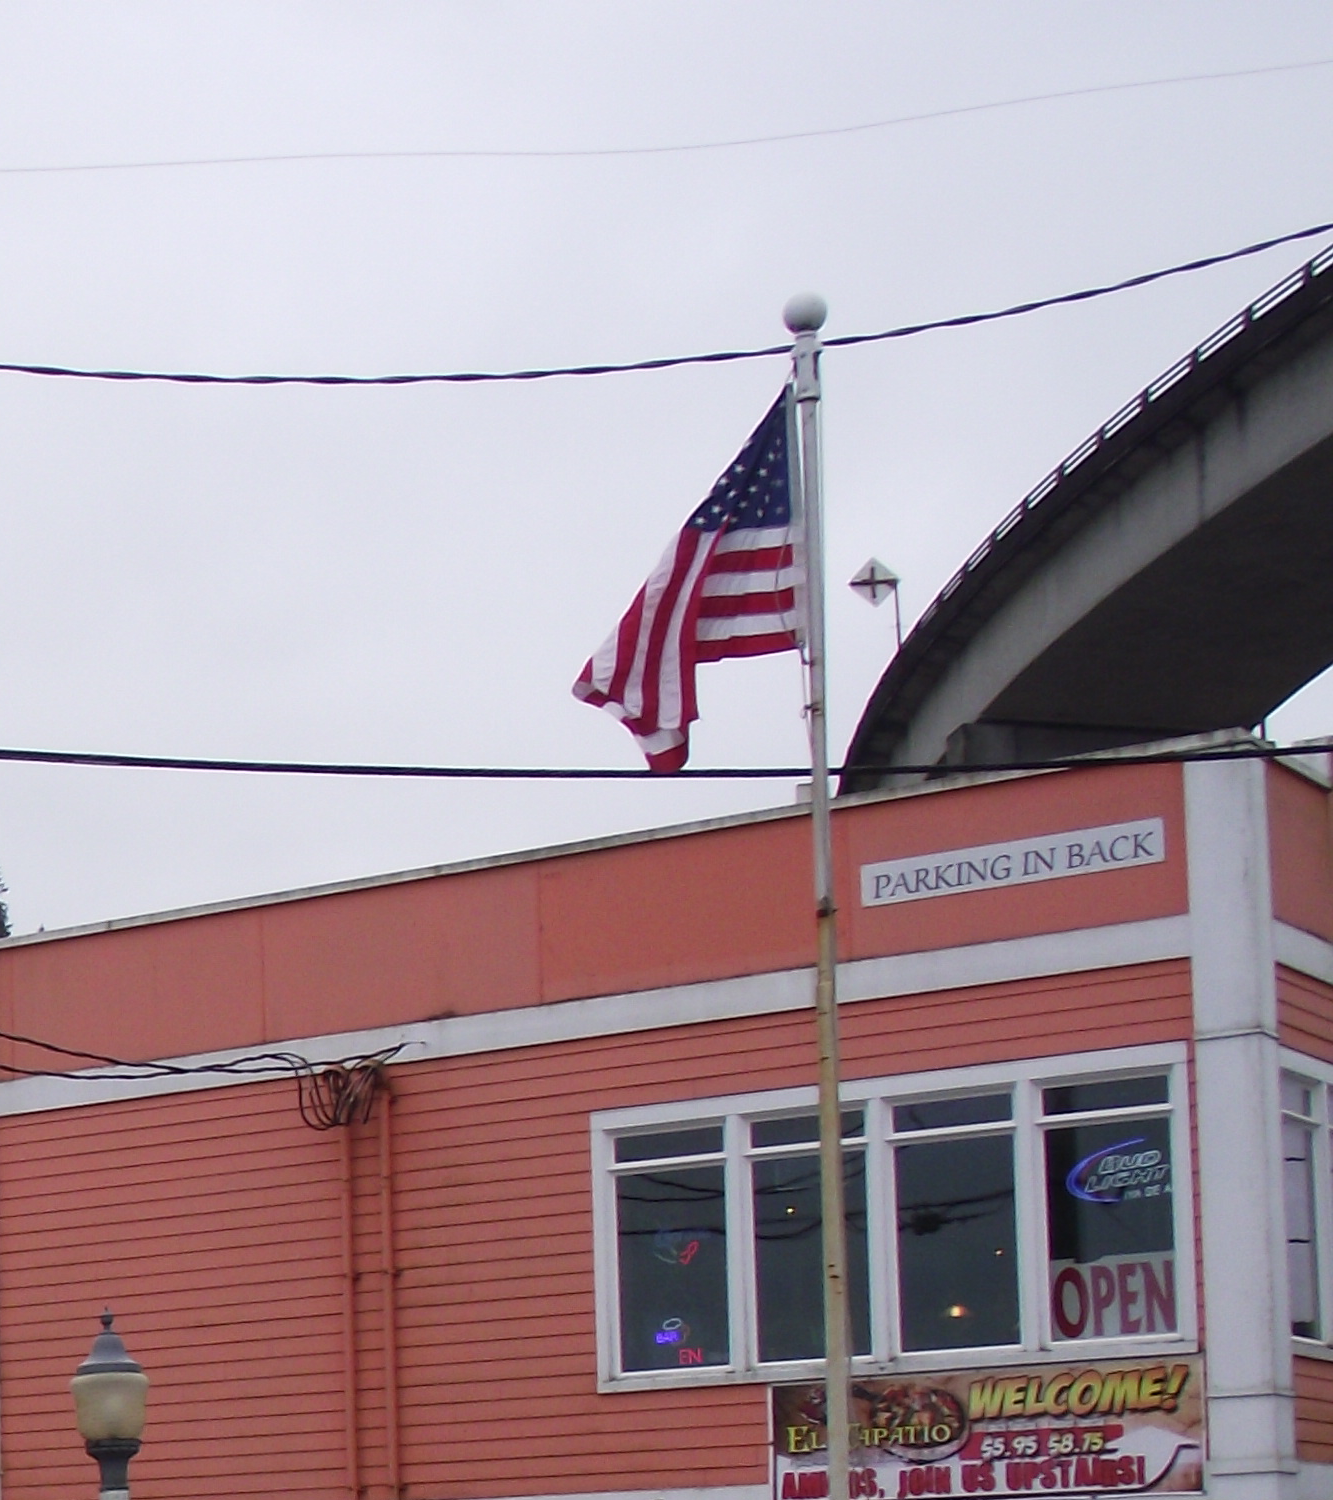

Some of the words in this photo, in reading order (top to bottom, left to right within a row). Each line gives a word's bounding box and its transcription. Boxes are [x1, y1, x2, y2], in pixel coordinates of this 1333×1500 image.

[873, 854, 1011, 899] PARKING
[1021, 847, 1057, 877] IN
[1066, 832, 1155, 869] BACK
[1084, 1164, 1170, 1193] LIGHT
[1098, 1150, 1162, 1175] BUD
[1053, 1260, 1178, 1338] OPEN
[969, 1364, 1189, 1419] WELCOME!
[782, 1467, 885, 1500] AMIOS,
[897, 1465, 952, 1500] JOIN
[961, 1459, 997, 1492] US
